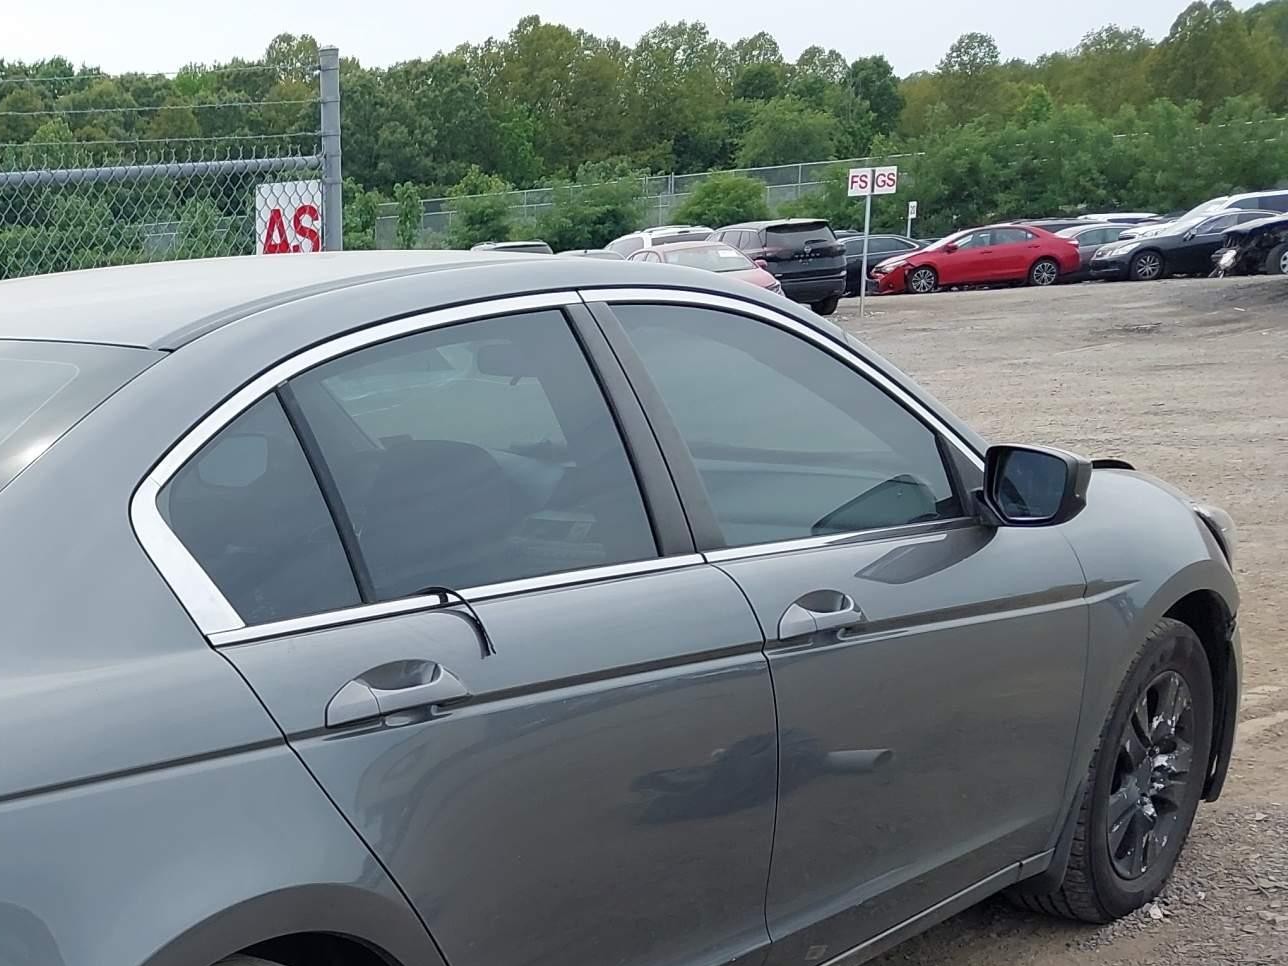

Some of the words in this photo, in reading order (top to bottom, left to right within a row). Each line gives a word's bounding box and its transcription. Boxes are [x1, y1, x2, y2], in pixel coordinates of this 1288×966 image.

[850, 174, 869, 190] FS
[875, 172, 896, 188] GS
[263, 204, 320, 254] AS
